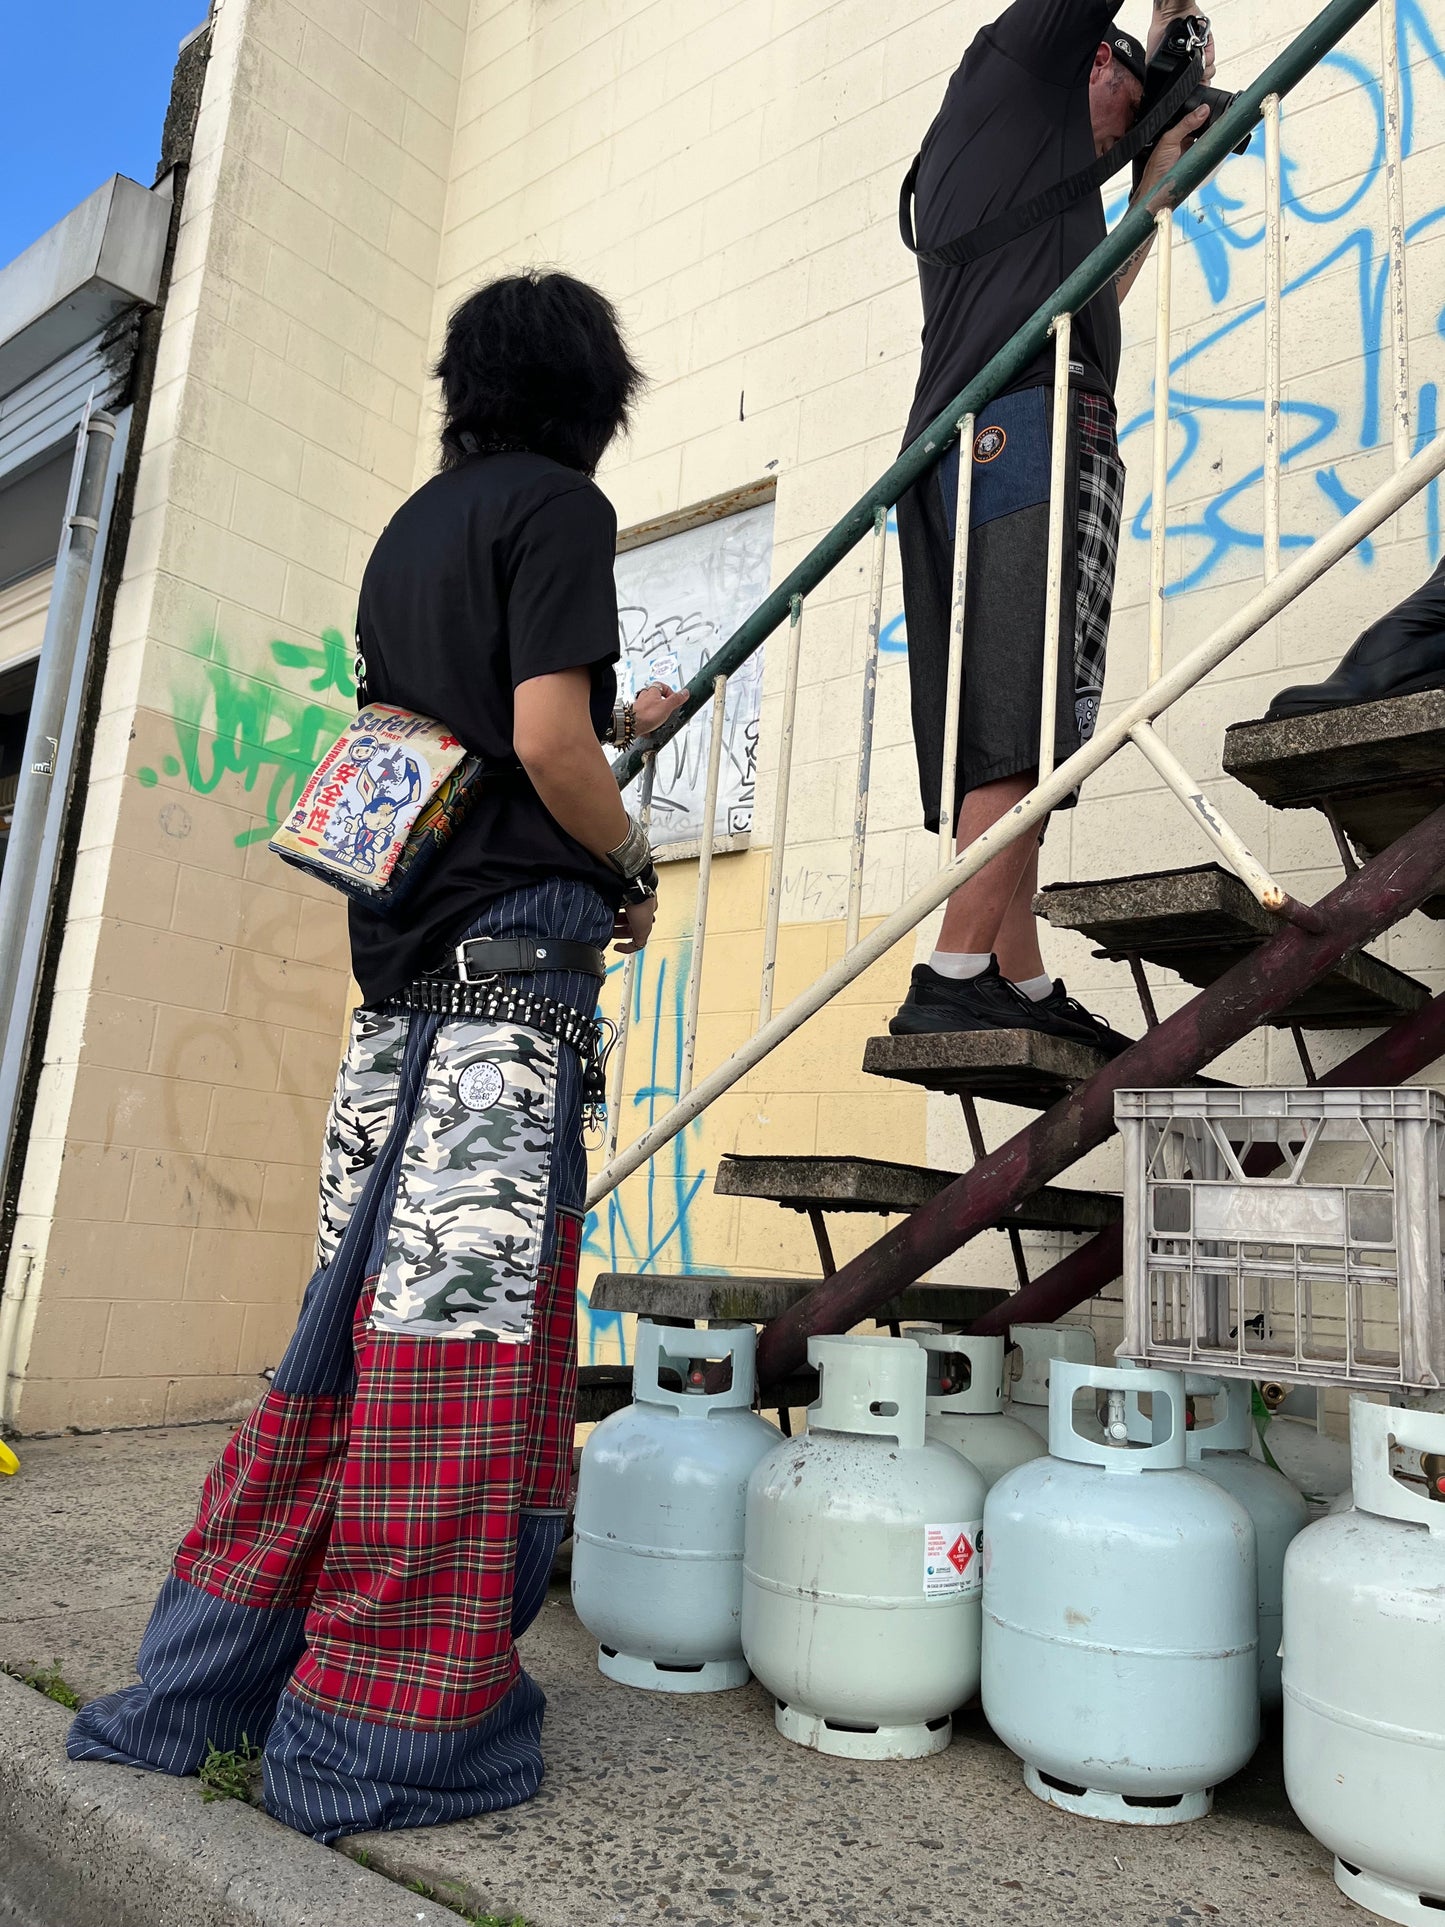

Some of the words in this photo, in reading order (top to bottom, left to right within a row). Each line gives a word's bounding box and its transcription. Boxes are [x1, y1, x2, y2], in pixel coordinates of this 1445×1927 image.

[350, 712, 441, 738] Safety!
[381, 731, 402, 741] FIRST
[298, 775, 320, 807] BOOMBOX
[315, 737, 349, 776] CORPORATION
[307, 762, 360, 833] 安全性
